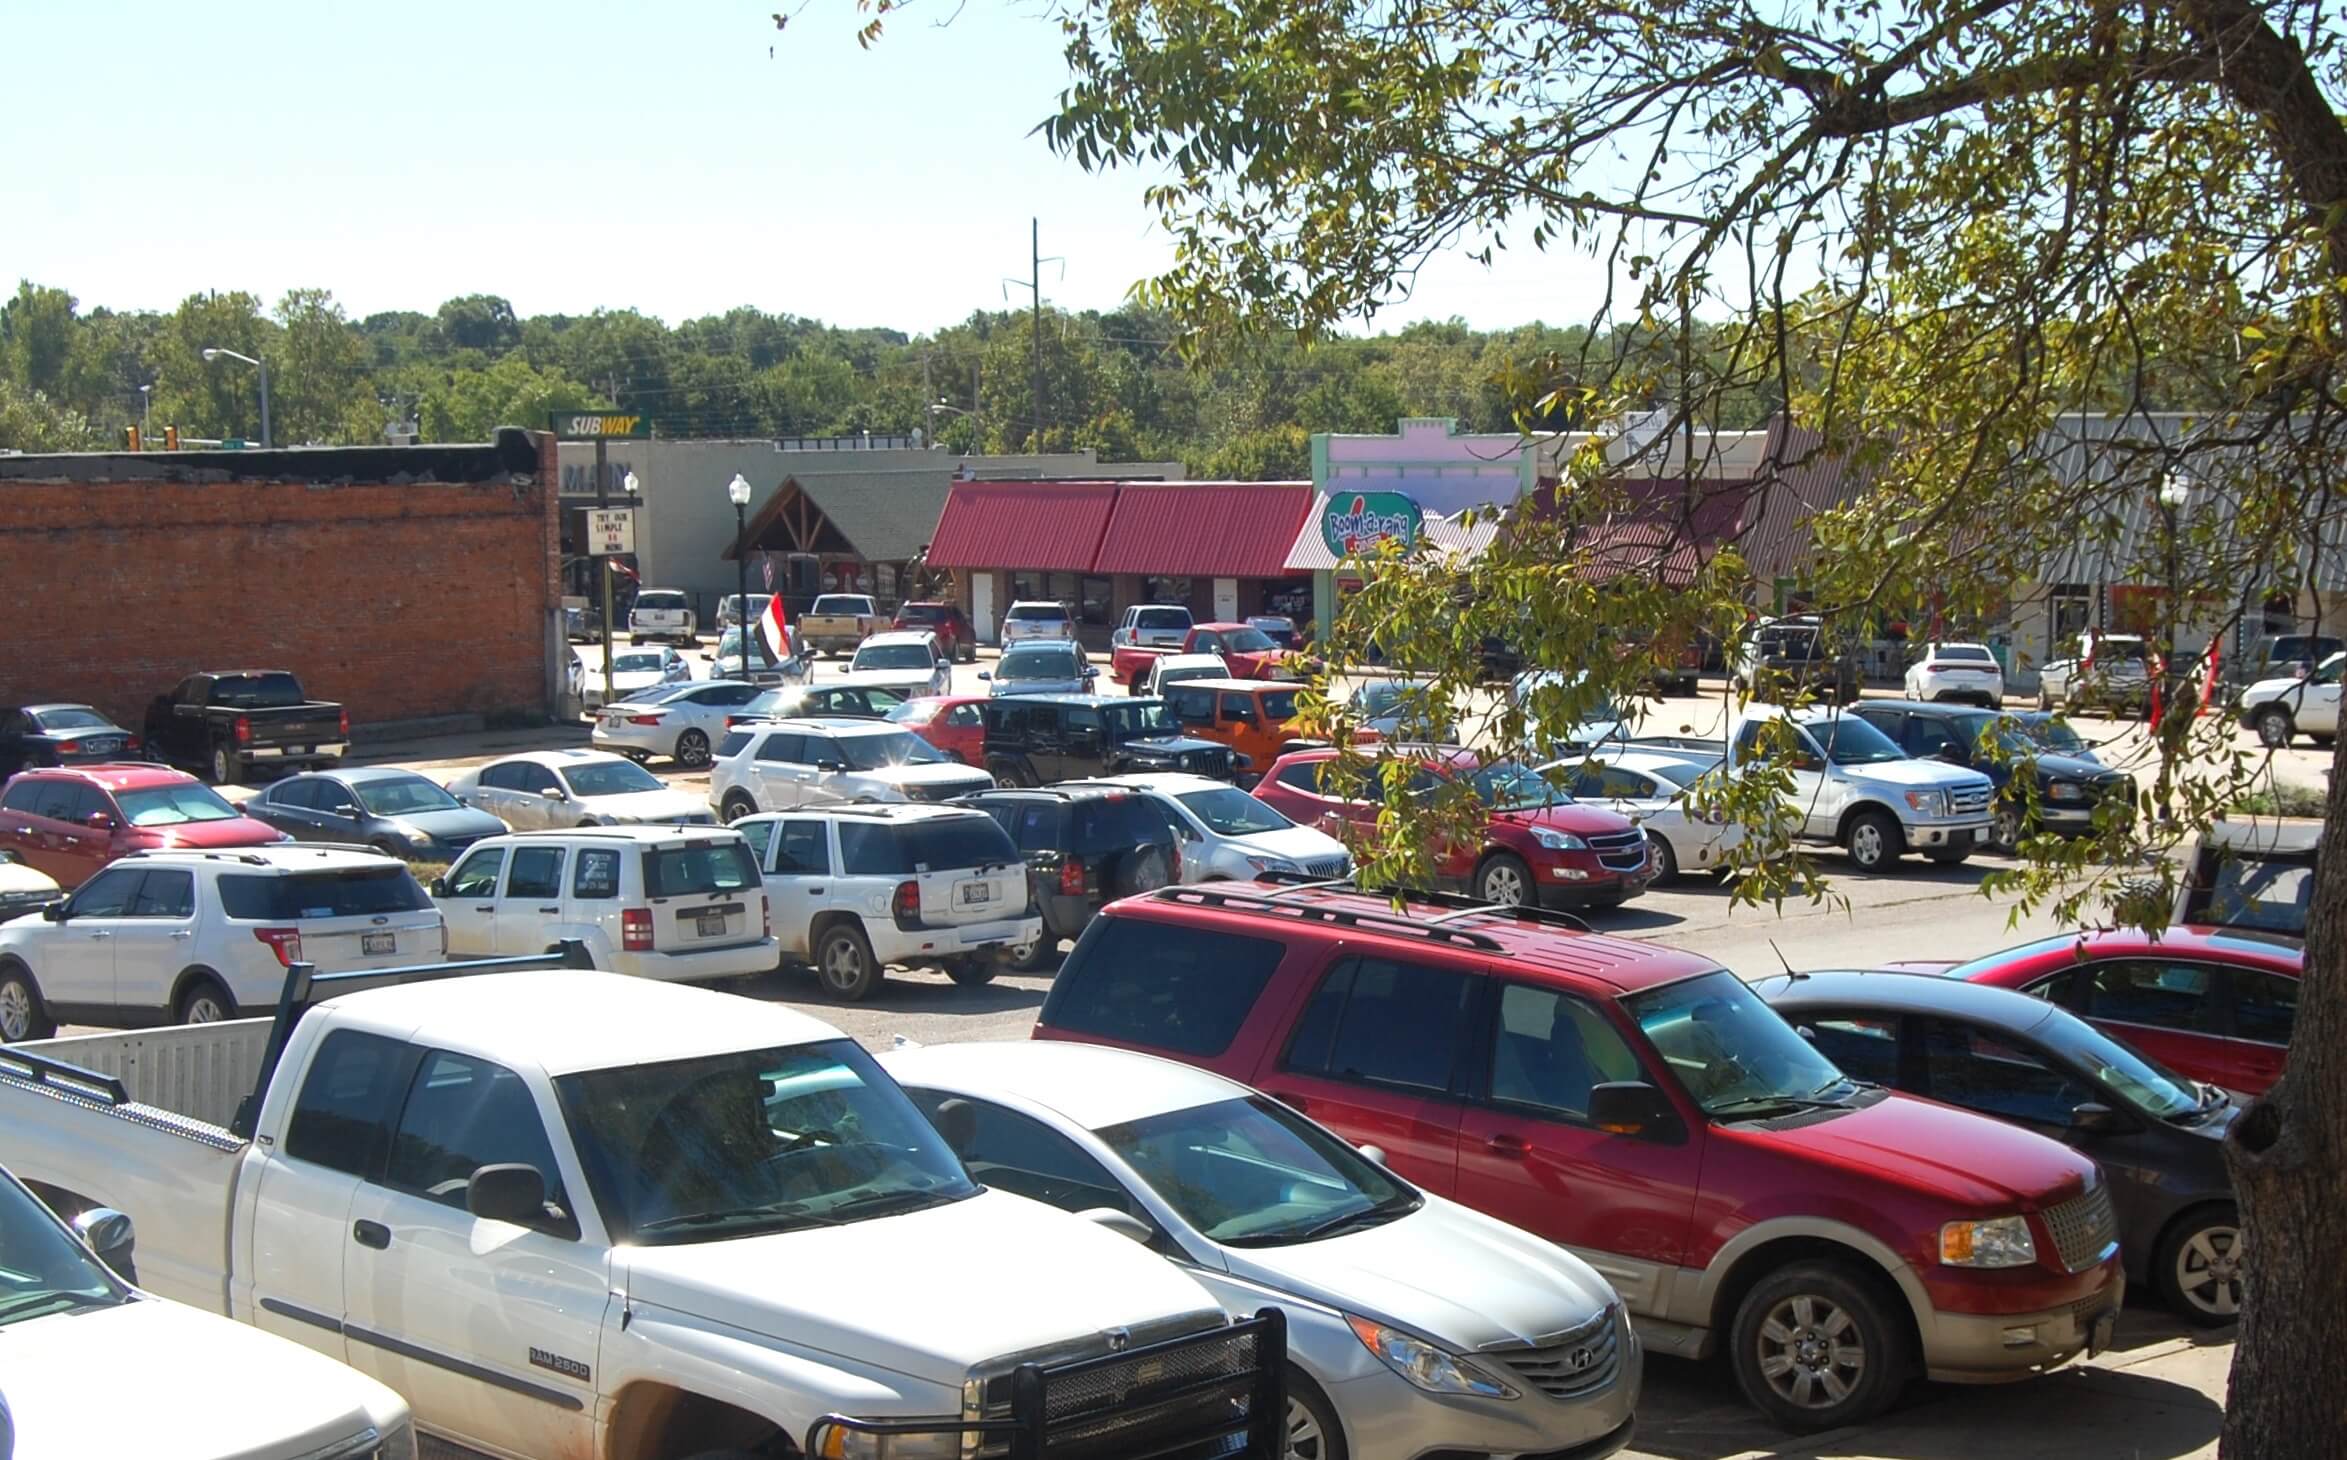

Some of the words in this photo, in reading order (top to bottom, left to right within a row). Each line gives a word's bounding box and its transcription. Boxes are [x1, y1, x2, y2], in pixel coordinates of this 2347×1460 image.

[567, 416, 640, 435] SUBWAY
[531, 1349, 555, 1366] RAM
[555, 1357, 588, 1376] 2500
